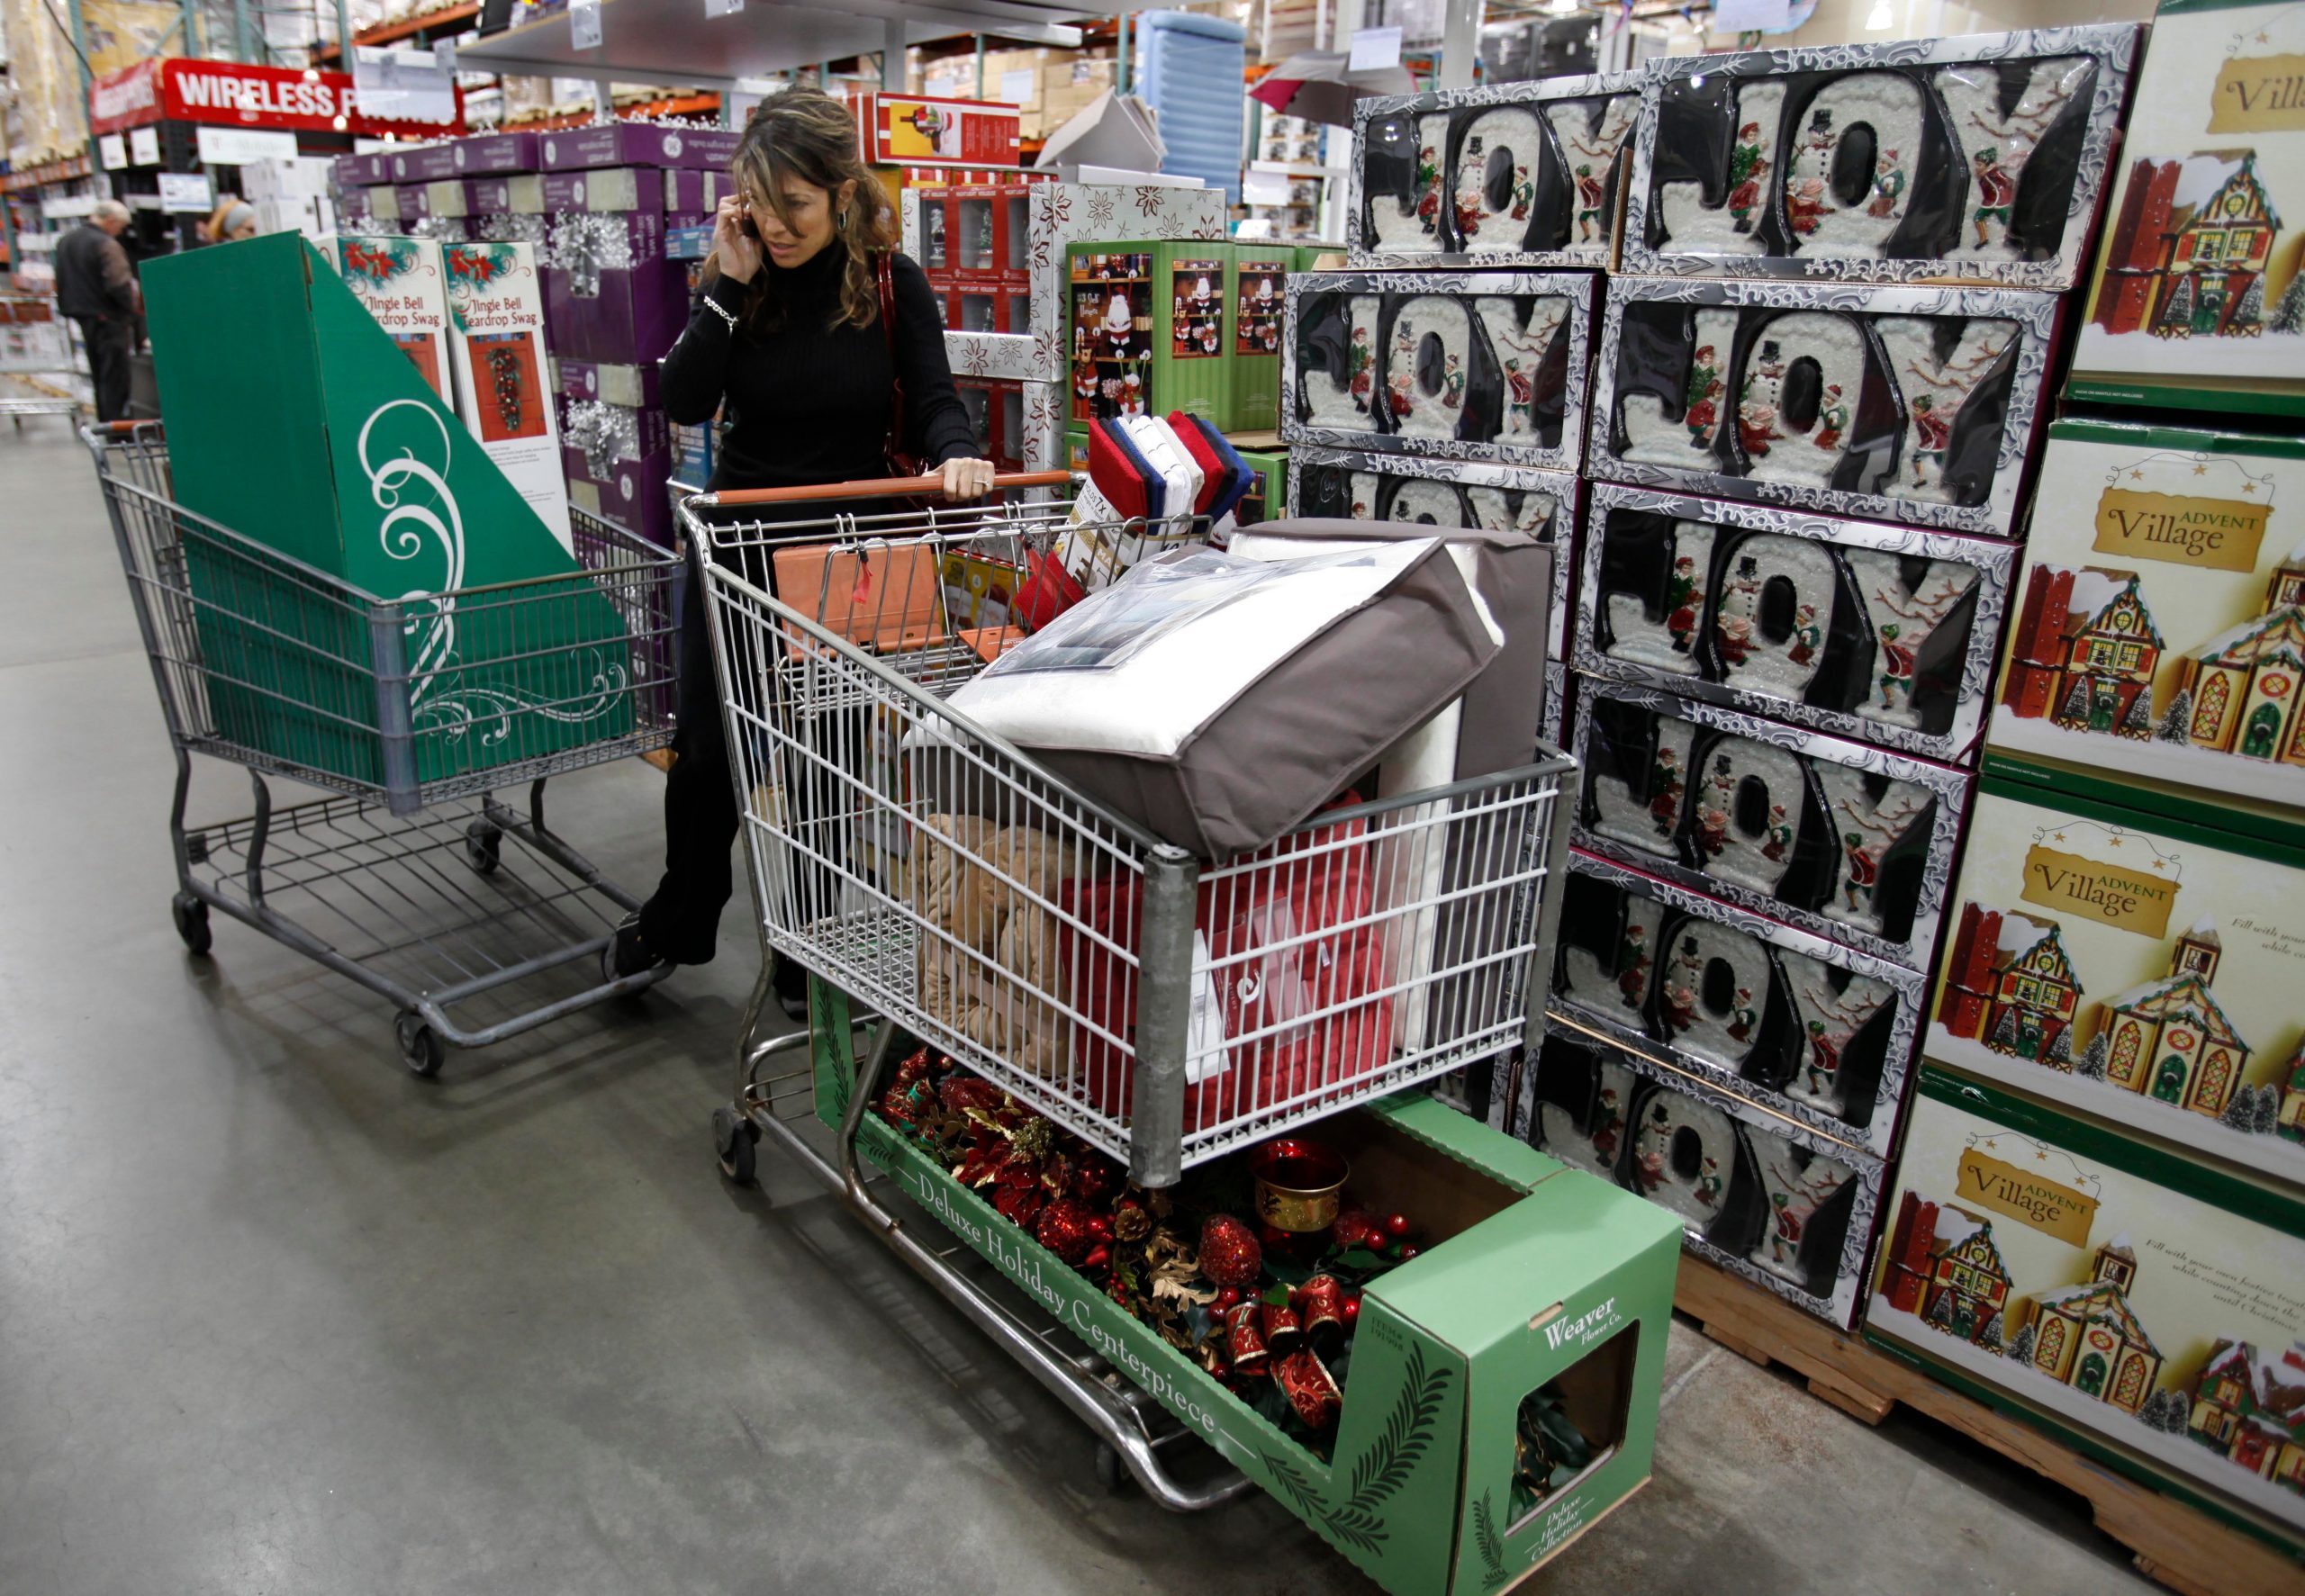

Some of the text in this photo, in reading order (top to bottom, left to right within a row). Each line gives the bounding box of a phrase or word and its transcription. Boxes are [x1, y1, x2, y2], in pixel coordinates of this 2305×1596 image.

[175, 71, 336, 118] WIRELESS
[368, 296, 423, 312] Jingle Bell
[377, 312, 440, 329] rdrop Swag
[462, 313, 538, 329] Teardrop Swag
[473, 297, 522, 314] Jingle Bell
[2108, 509, 2225, 556] Village
[2179, 510, 2260, 531] ADVENT
[2033, 862, 2138, 916] Village
[2096, 875, 2167, 901] ADVENT
[2231, 918, 2254, 930] Fill
[2253, 926, 2277, 937] with
[2261, 942, 2291, 955] while
[1967, 1165, 2061, 1222] Village
[2024, 1183, 2088, 1216] ADVENT
[2146, 1239, 2165, 1250] Fill
[2165, 1249, 2188, 1261] with
[2188, 1259, 2213, 1272] your
[918, 1172, 1216, 1434] Deluxe Holiday Centerpiece
[2172, 1264, 2199, 1278] while
[2282, 1308, 2300, 1320] the
[1542, 1296, 1614, 1350] Weaver
[1581, 1312, 1622, 1347] Flower Co.
[2212, 1294, 2299, 1332] until Christmas
[1541, 1507, 1580, 1544] Holiday
[1546, 1496, 1581, 1528] Deluxe
[1531, 1519, 1582, 1562] Collection
